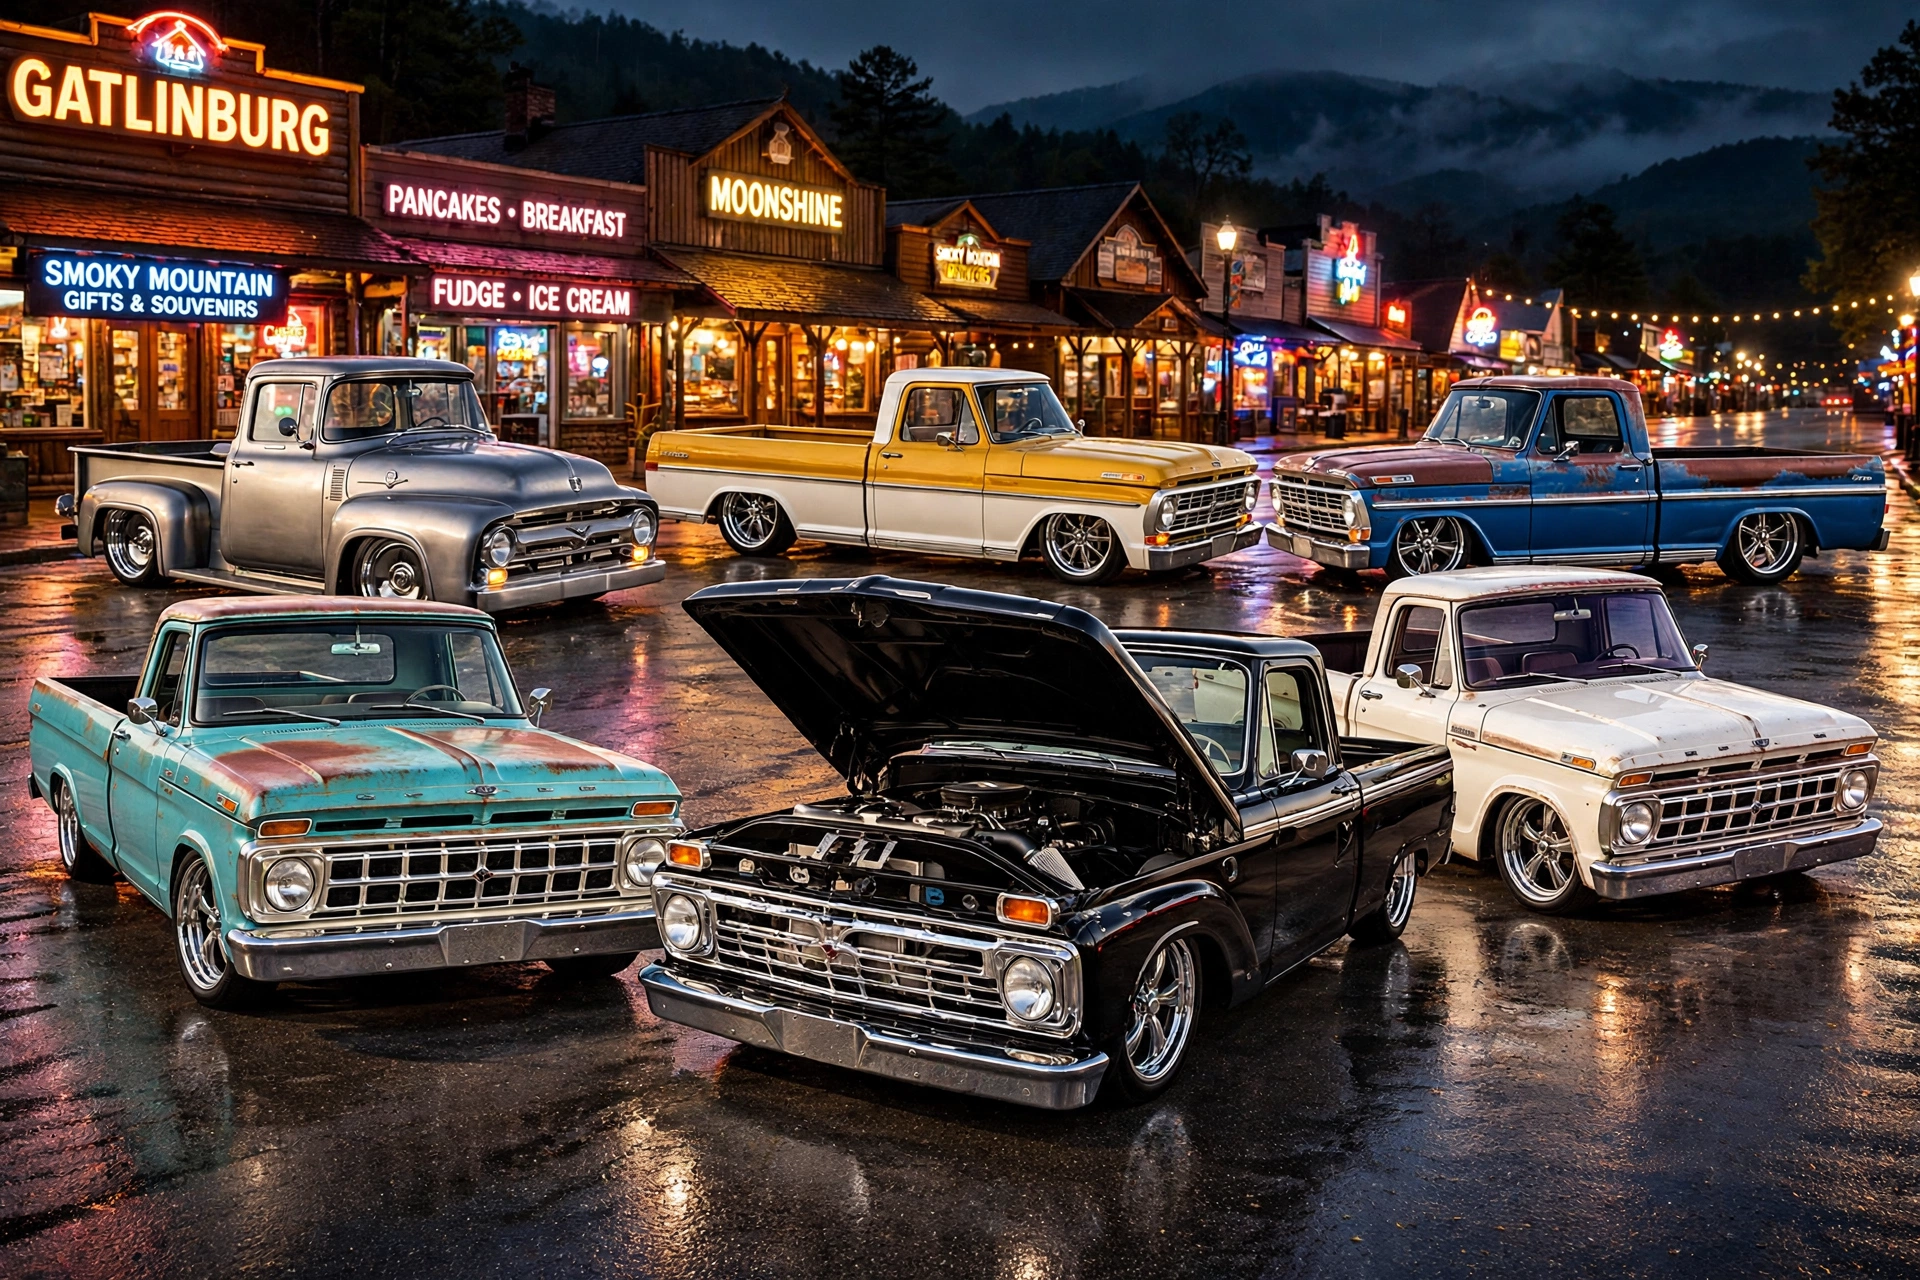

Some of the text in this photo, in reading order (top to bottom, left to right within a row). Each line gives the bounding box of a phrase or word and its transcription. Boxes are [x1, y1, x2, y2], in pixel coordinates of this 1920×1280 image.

[13, 58, 331, 156] GATLINBURG
[389, 184, 627, 238] PANCAKES BREAKFAST
[710, 175, 843, 228] MOONSHINE
[45, 259, 273, 298] SMOKY MOUNTAIN
[434, 278, 631, 316] FUDGE ICE CREAM
[63, 290, 259, 319] GIFTS & SOUVENIRS
